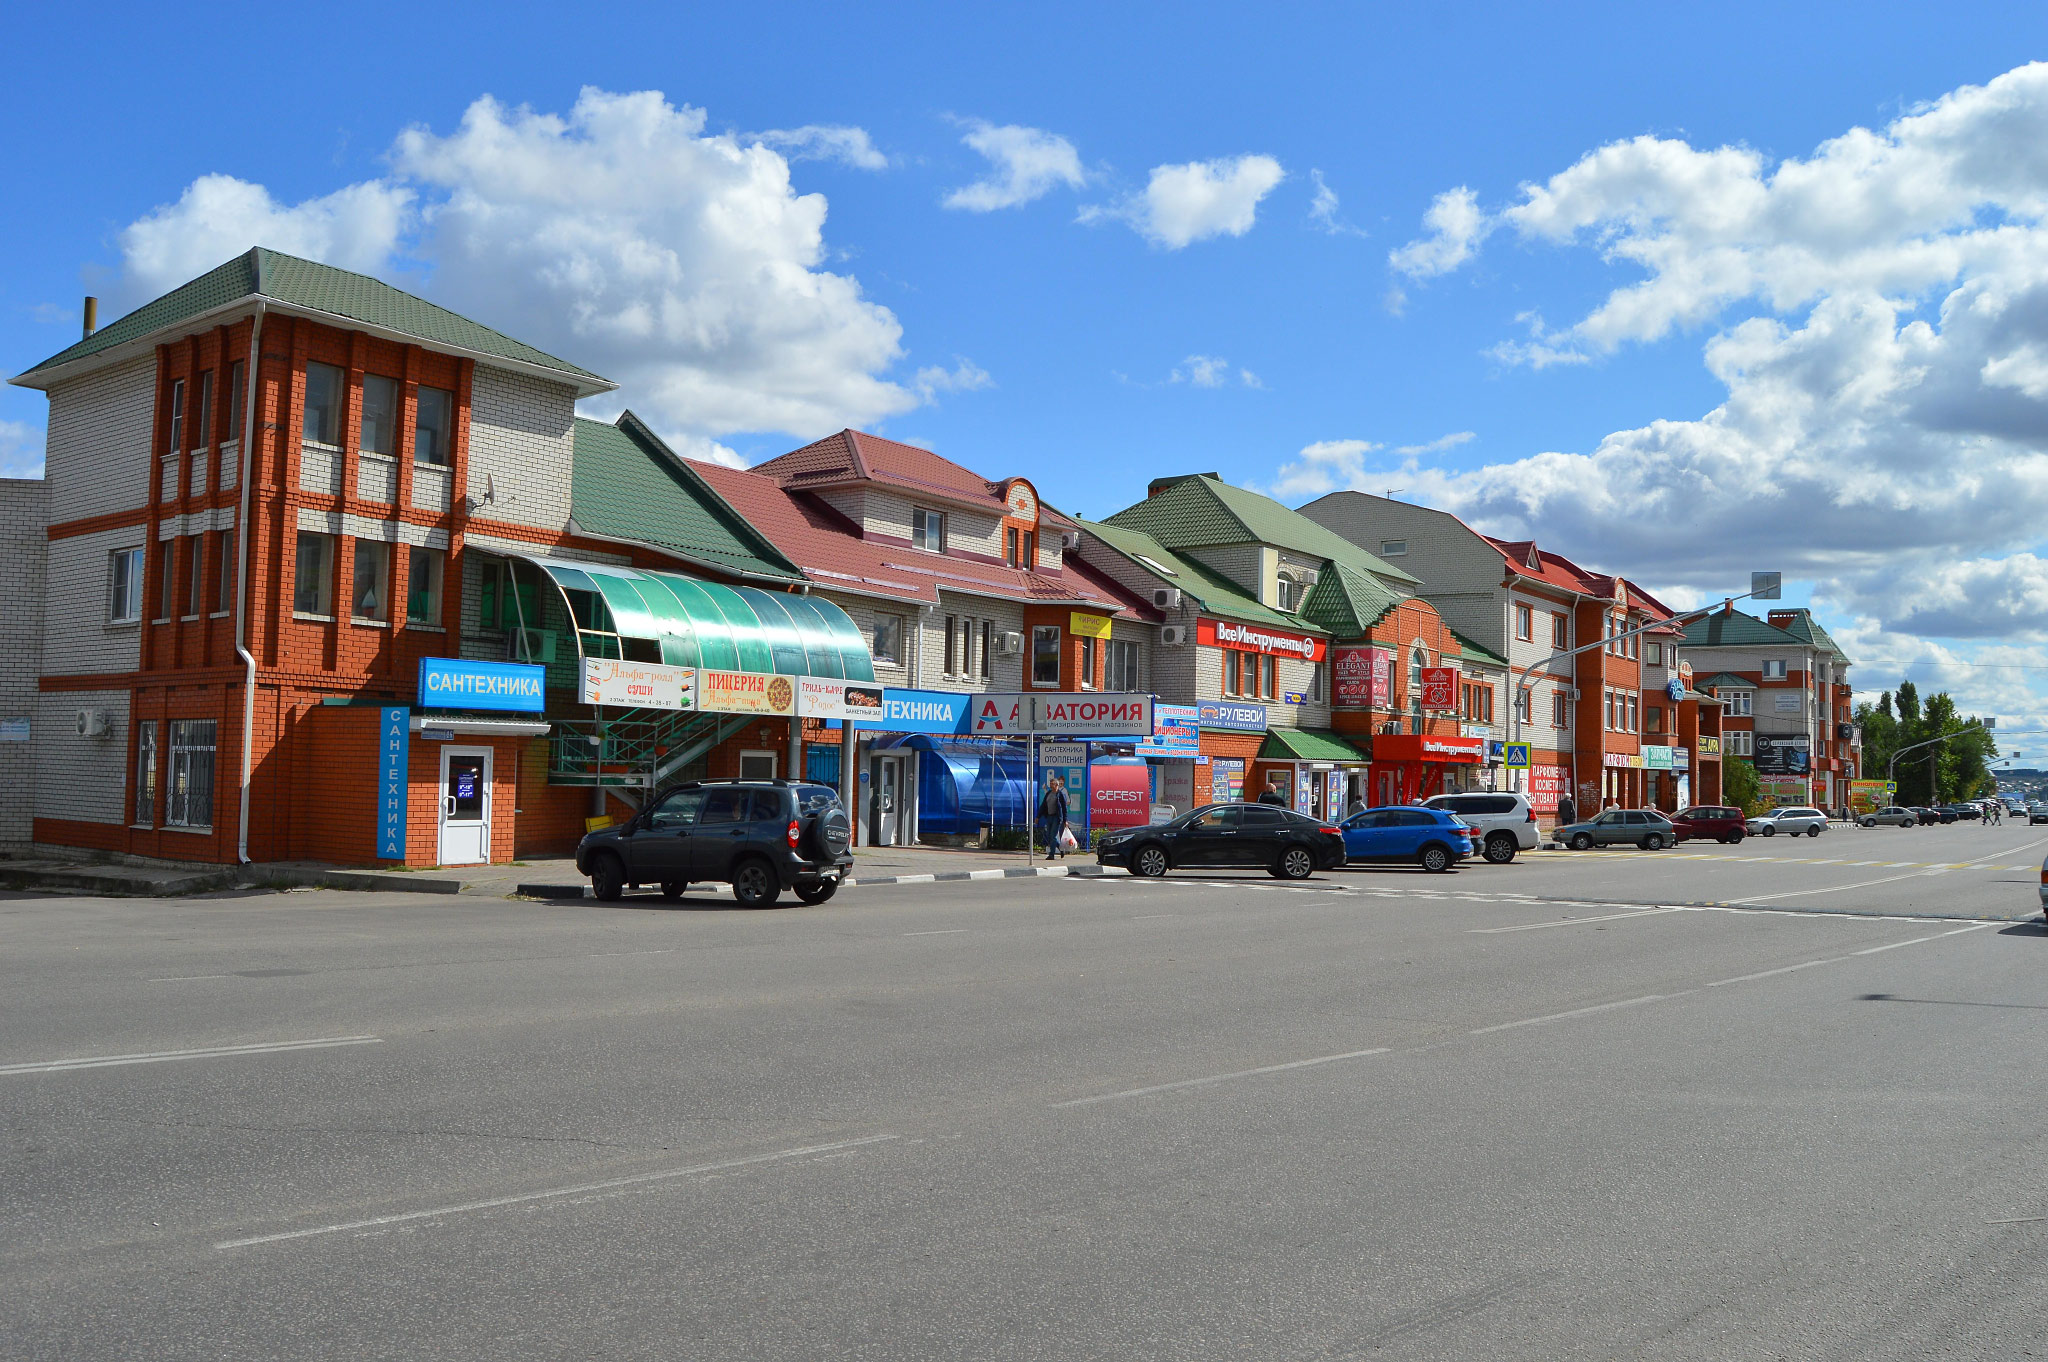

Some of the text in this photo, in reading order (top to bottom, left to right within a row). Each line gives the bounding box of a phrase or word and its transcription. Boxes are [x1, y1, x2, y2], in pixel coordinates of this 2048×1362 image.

[1336, 662, 1370, 670] ELEGANT
[428, 672, 541, 697] САНТЕХНИКА
[708, 673, 765, 692] ПИЦЕРИЯ
[801, 682, 843, 695] ГРИЛЬ-КАФЕ
[627, 684, 654, 696] СУШИ
[845, 708, 871, 716] БАНКЕТНЫЙ
[883, 700, 953, 722] ТЕХНИКА
[1009, 702, 1143, 721] АВАТОРИЯ
[1219, 706, 1263, 723] РУЛЕВОЙ
[1044, 755, 1084, 764] ОТОПЛЕНИЕ
[1604, 753, 1630, 767] ПАРФЮМ
[1532, 765, 1568, 778] ПАРФЮМЕРИЯ
[386, 710, 401, 853] САНТЕХНИКА
[1535, 779, 1565, 791] КОСМЕТИКА
[1096, 789, 1144, 802] GEFEST
